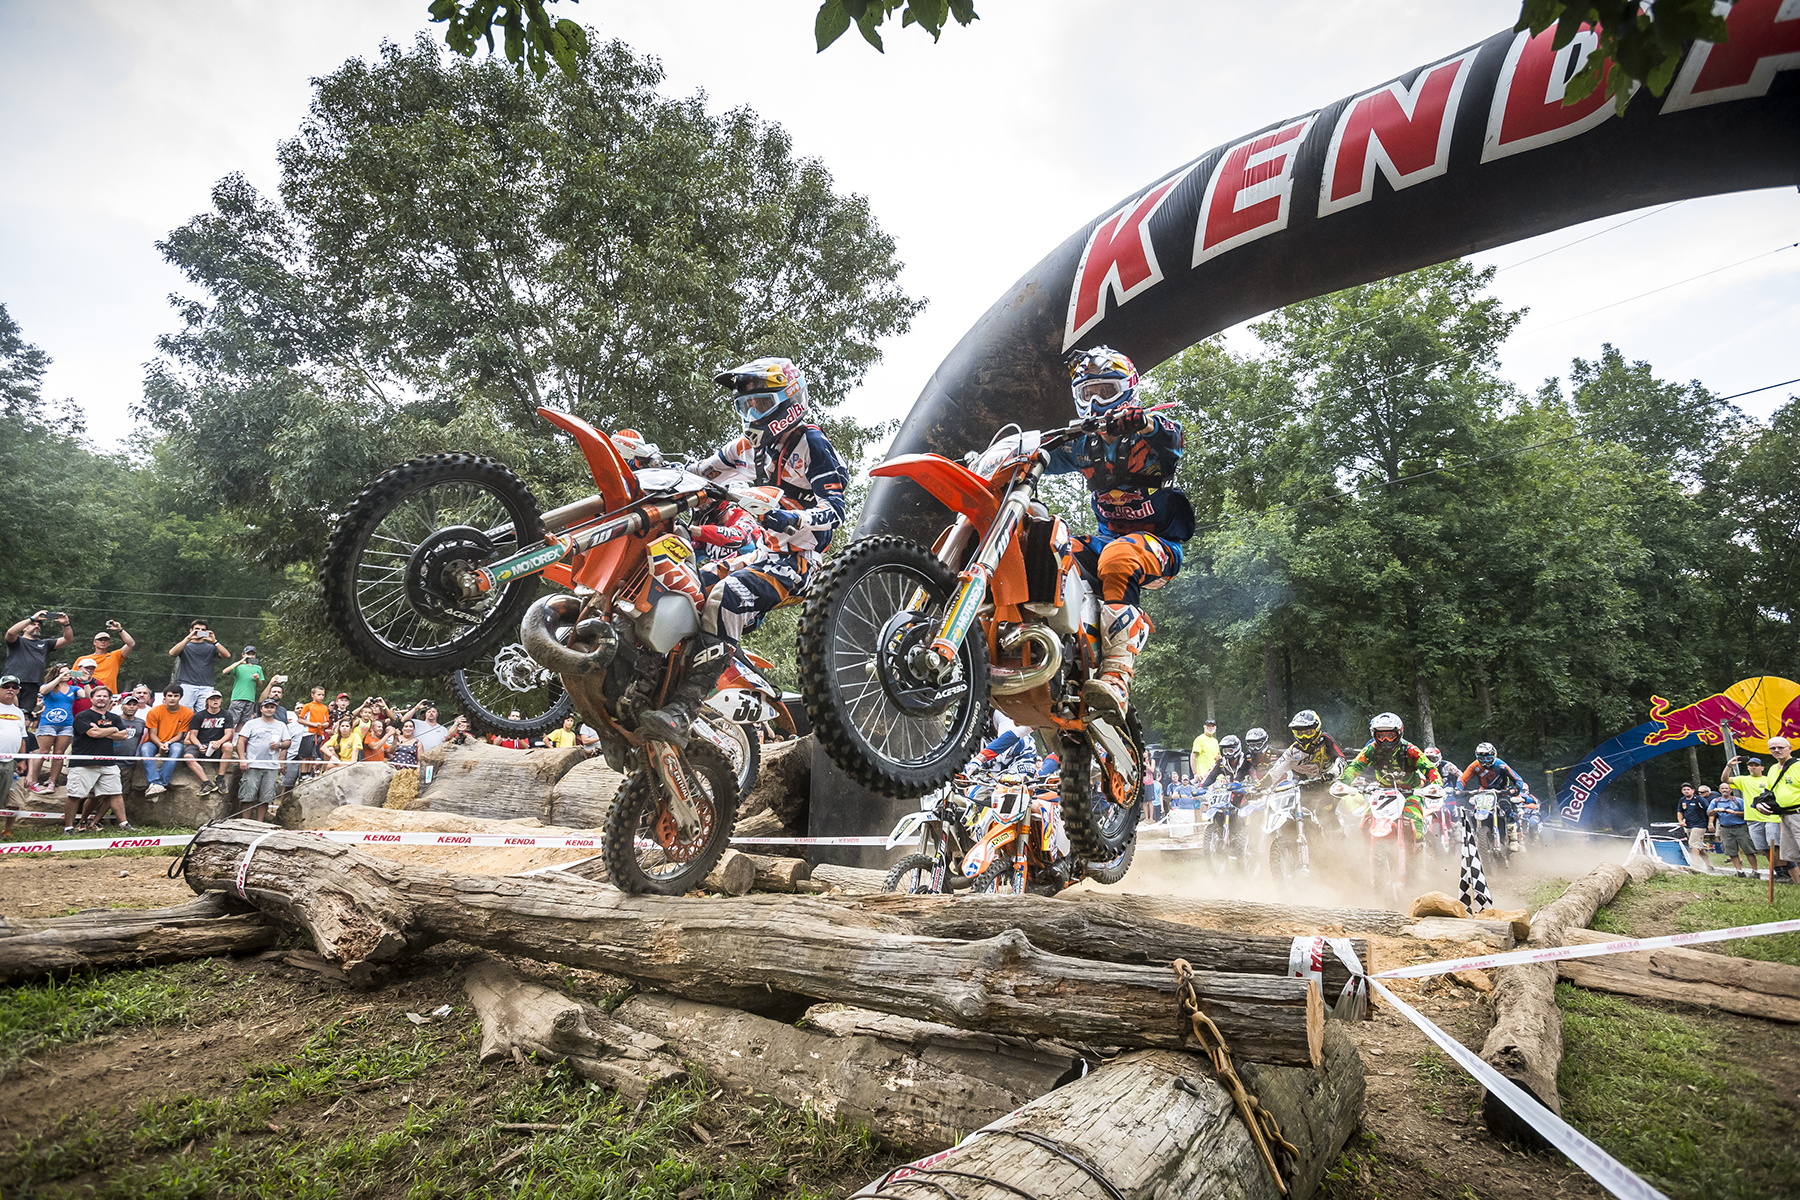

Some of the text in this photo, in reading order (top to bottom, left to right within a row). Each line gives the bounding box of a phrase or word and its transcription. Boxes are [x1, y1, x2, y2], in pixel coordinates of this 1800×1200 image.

[768, 408, 796, 436] Red
[1122, 500, 1155, 520] Bull
[662, 538, 688, 560] FMF
[511, 548, 561, 577] MOTOREX
[956, 583, 984, 630] MOTOREX
[1211, 794, 1230, 805] 314
[1561, 756, 1613, 822] Red Bull
[1376, 796, 1397, 811] 7
[0, 844, 52, 853] KENDA
[110, 838, 161, 848] KENDA
[363, 834, 401, 842] KENDA
[437, 836, 471, 844] KENDA
[504, 837, 535, 846] KENDA
[565, 839, 594, 847] KENDA
